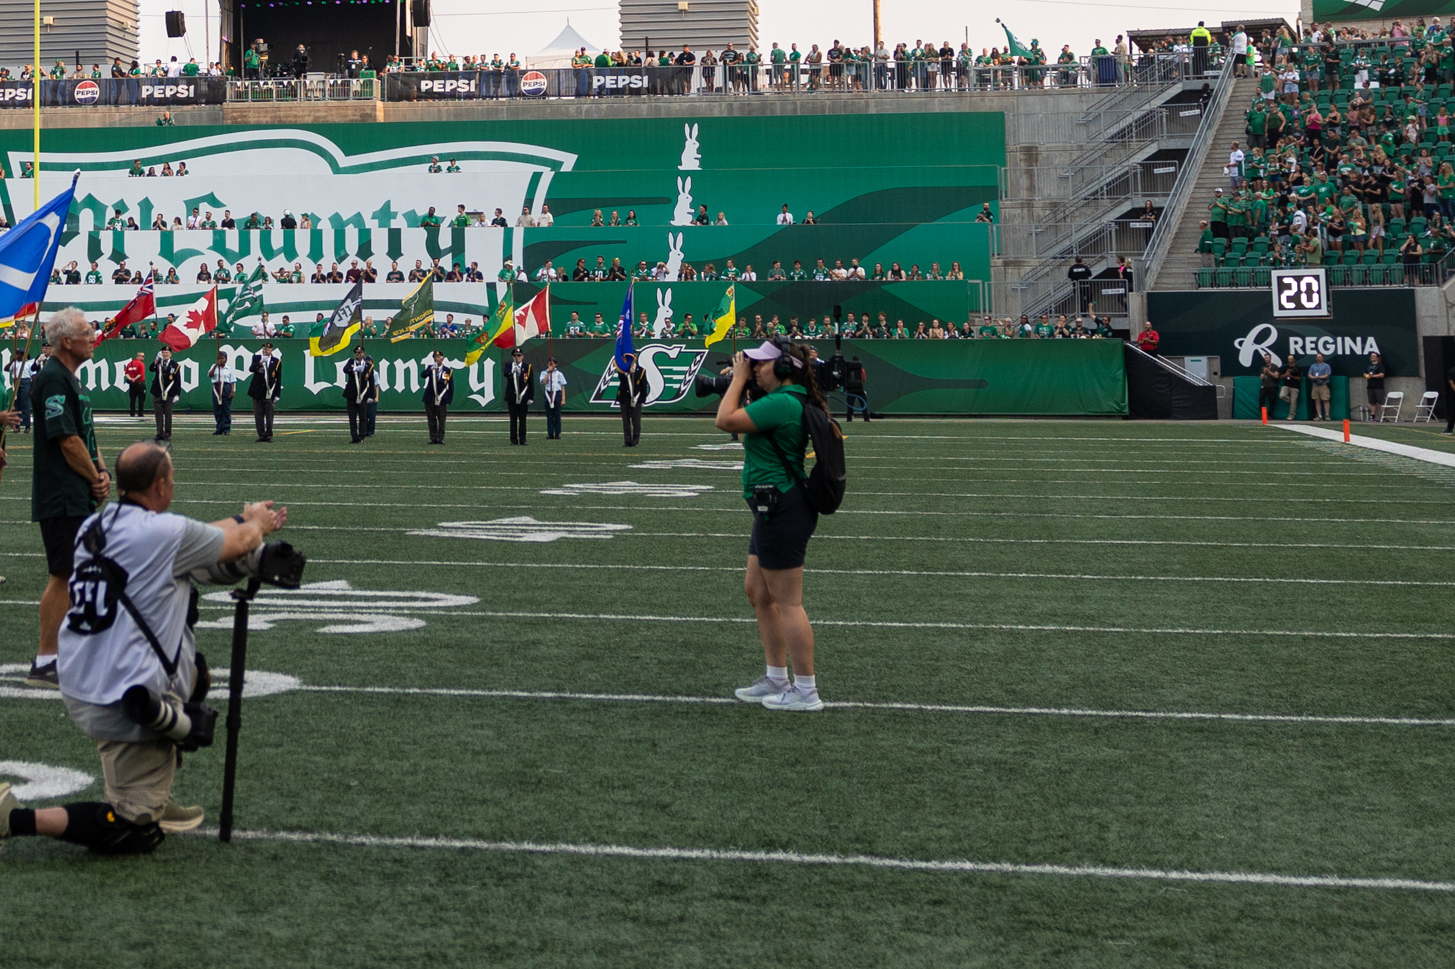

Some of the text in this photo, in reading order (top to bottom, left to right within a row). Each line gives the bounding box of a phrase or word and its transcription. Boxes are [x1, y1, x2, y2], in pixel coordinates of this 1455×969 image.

[420, 79, 476, 93] PEPSI
[592, 75, 648, 89] PEPSI
[76, 89, 98, 97] PEPSI
[141, 85, 195, 98] PEPSI
[158, 190, 468, 274] Country
[1280, 276, 1320, 309] 20
[1288, 336, 1381, 356] REGINA
